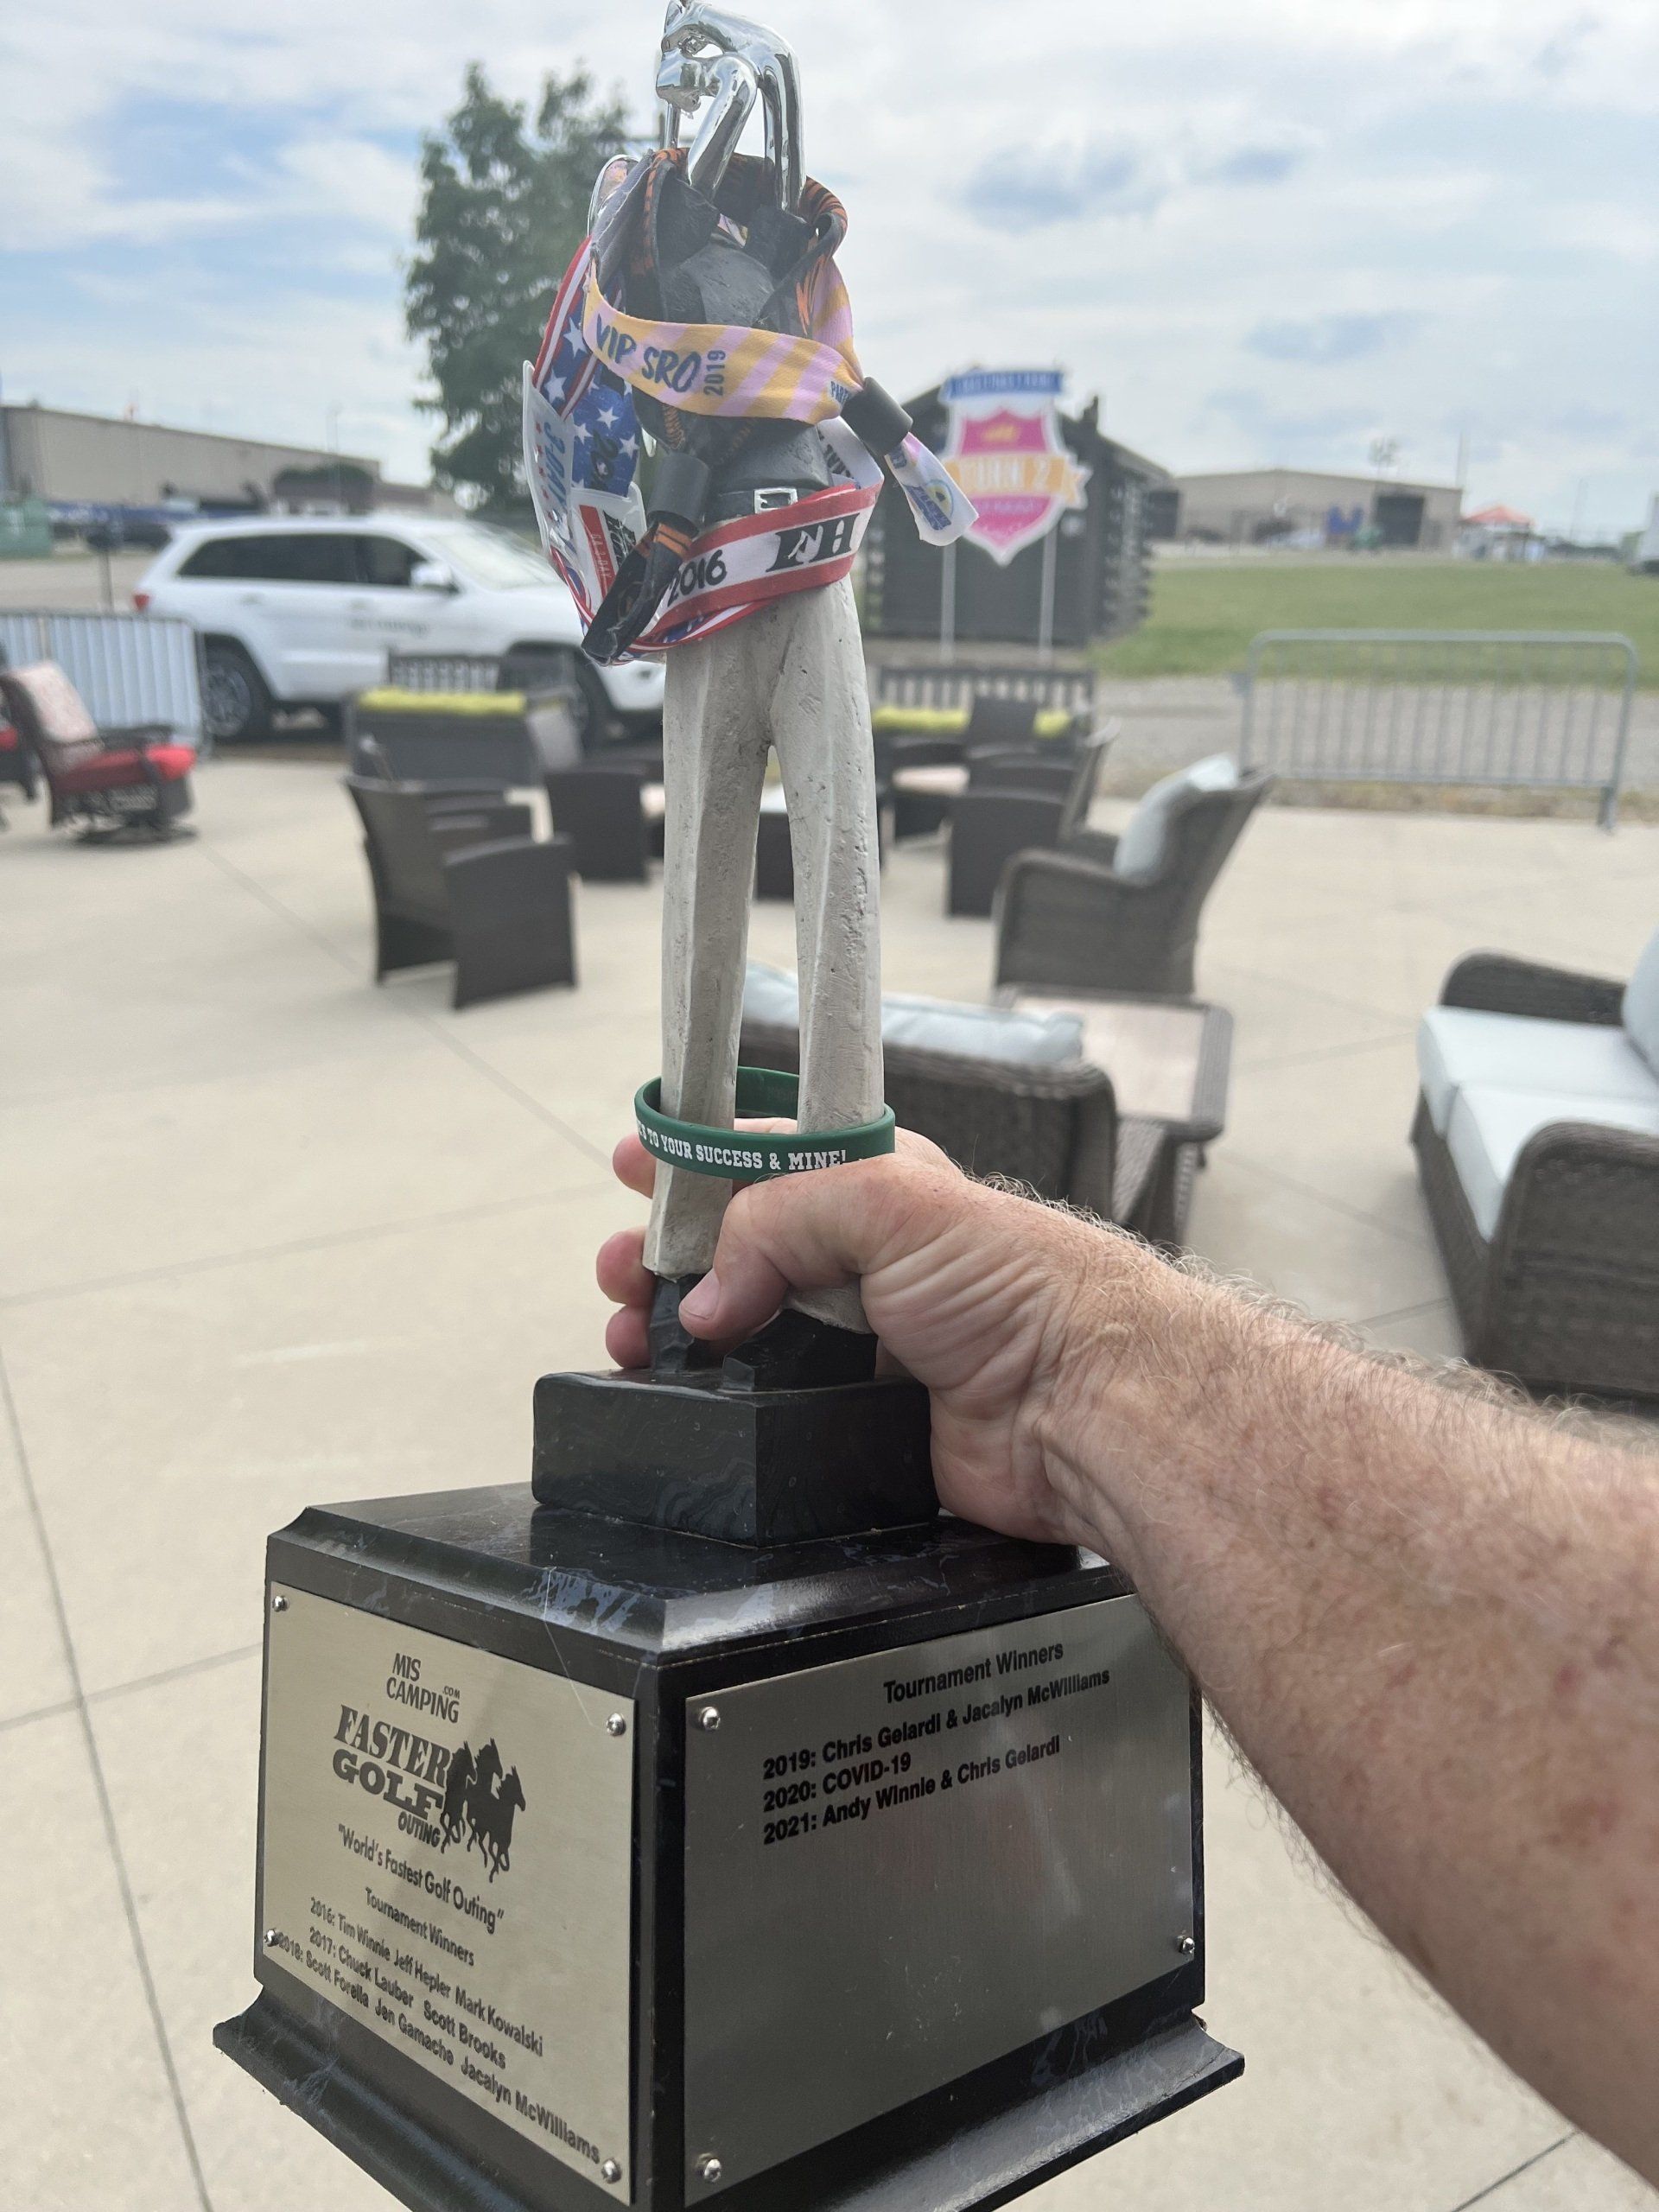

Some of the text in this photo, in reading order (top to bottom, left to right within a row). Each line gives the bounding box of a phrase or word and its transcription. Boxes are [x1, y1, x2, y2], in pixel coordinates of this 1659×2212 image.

[596, 313, 702, 393] VIP SRO
[703, 349, 726, 396] 2019
[667, 550, 728, 607] 2016
[646, 1128, 659, 1147] TO
[661, 1135, 693, 1160] YOUR
[696, 1144, 763, 1169] SUCCESS
[769, 1153, 781, 1170] &
[386, 1676, 460, 1723] CAMPING
[392, 1653, 422, 1681] MIS
[883, 1643, 1065, 1703] Tournament Winners
[334, 1704, 450, 1789] FASTER
[763, 1669, 1110, 1780] 2019: Chris Gelardi & Jacalyn McWilliams
[333, 1749, 445, 1820] GOLF
[763, 1752, 912, 1812] 2020: COVID-19
[763, 1735, 1060, 1845] 2021: Andy Winnie & Chris Gelardi
[397, 1811, 441, 1847] OUTING
[365, 1886, 474, 1967] Tournament Winners
[385, 1848, 423, 1888] Fastest
[425, 1871, 451, 1903] Golf
[453, 1885, 505, 1935] Outing"
[309, 1926, 336, 1958] 2017:
[339, 1945, 372, 1982] Chuck
[423, 1999, 455, 2037] Scott
[459, 2022, 505, 2069] Brooks
[310, 1897, 334, 1926] 2016:
[338, 1913, 355, 1938] Tim
[357, 1924, 390, 1961] Winnie
[394, 1949, 413, 1975] Jeff
[455, 1985, 486, 2022] Mark
[487, 2005, 543, 2057] Kowalski
[306, 1949, 332, 1983] Scott
[375, 1997, 395, 2025] Jen
[461, 2056, 512, 2105] Jacalyn
[515, 2089, 601, 2164] McWilliams
